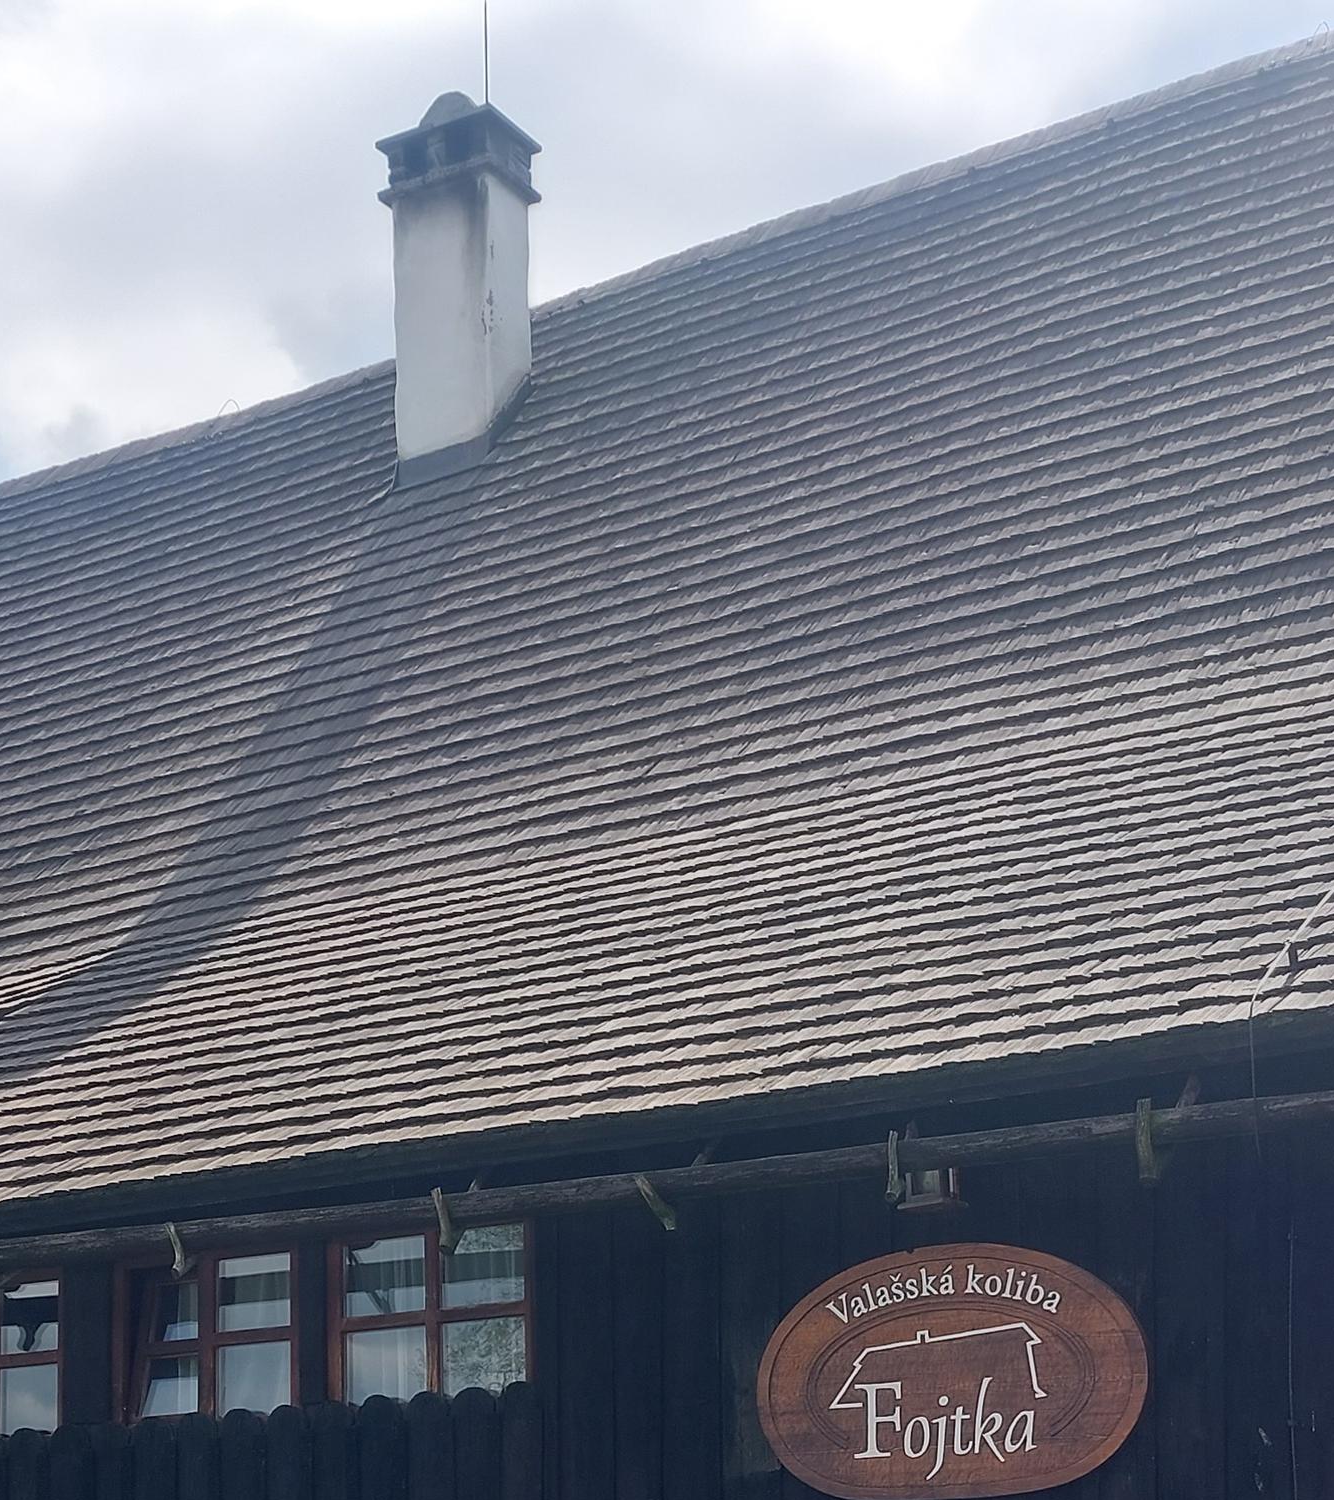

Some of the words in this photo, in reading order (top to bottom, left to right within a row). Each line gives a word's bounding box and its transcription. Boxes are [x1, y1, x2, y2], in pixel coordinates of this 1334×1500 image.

[825, 1264, 956, 1325] Valašská
[963, 1263, 1062, 1315] koliba
[853, 1376, 1038, 1481] Fojtka
